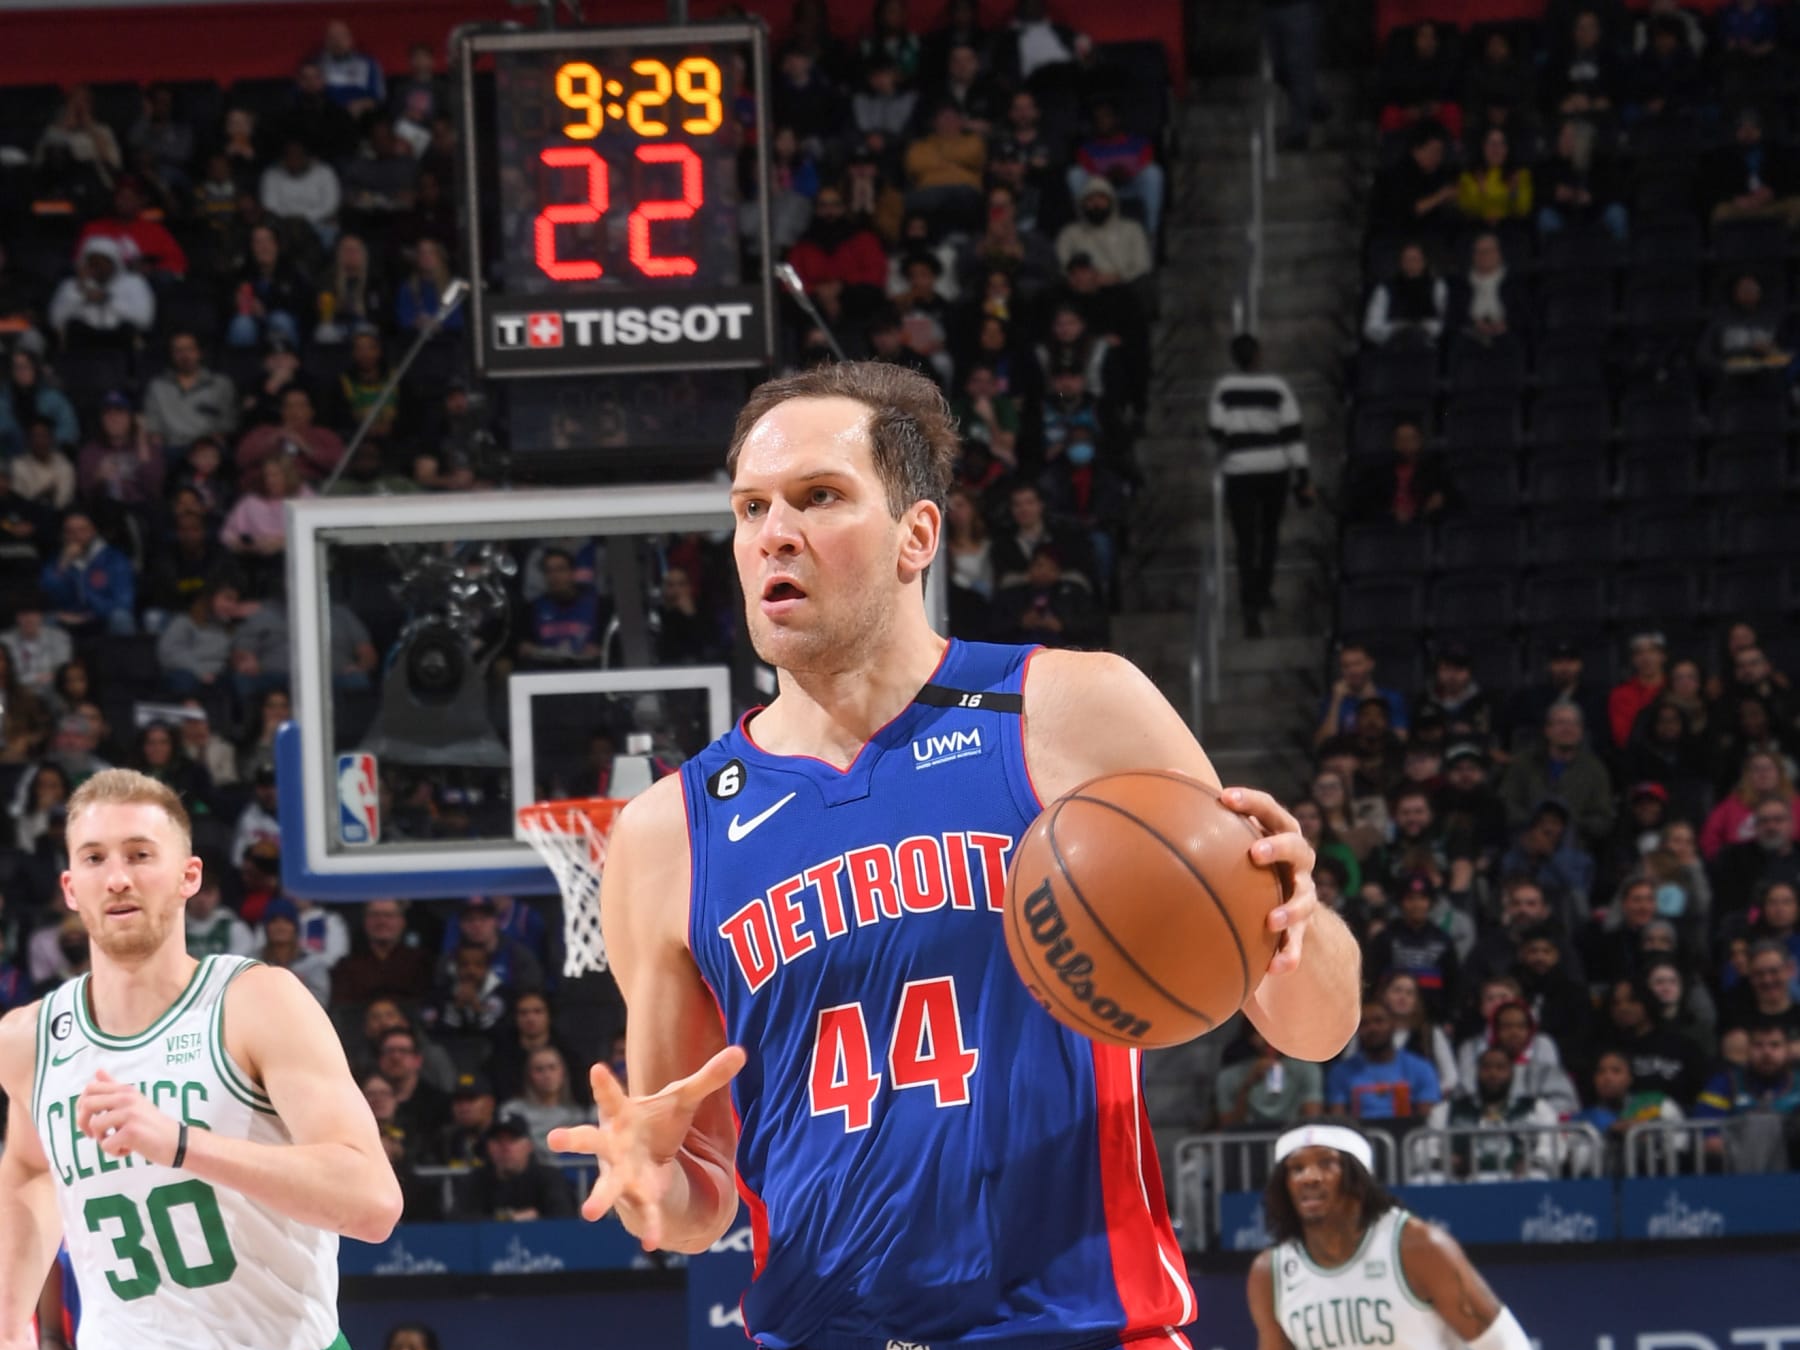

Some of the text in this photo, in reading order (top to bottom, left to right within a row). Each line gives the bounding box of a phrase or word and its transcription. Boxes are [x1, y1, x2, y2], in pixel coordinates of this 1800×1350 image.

[555, 57, 723, 140] 9:29
[533, 142, 704, 281] 22
[565, 303, 752, 346] TISSOT
[913, 728, 982, 761] UWM
[958, 693, 983, 708] 16
[717, 764, 740, 797] 6
[718, 831, 1013, 995] DETROIT
[1024, 875, 1153, 1039] Wilson
[808, 975, 980, 1134] 44
[83, 1178, 239, 1302] 30
